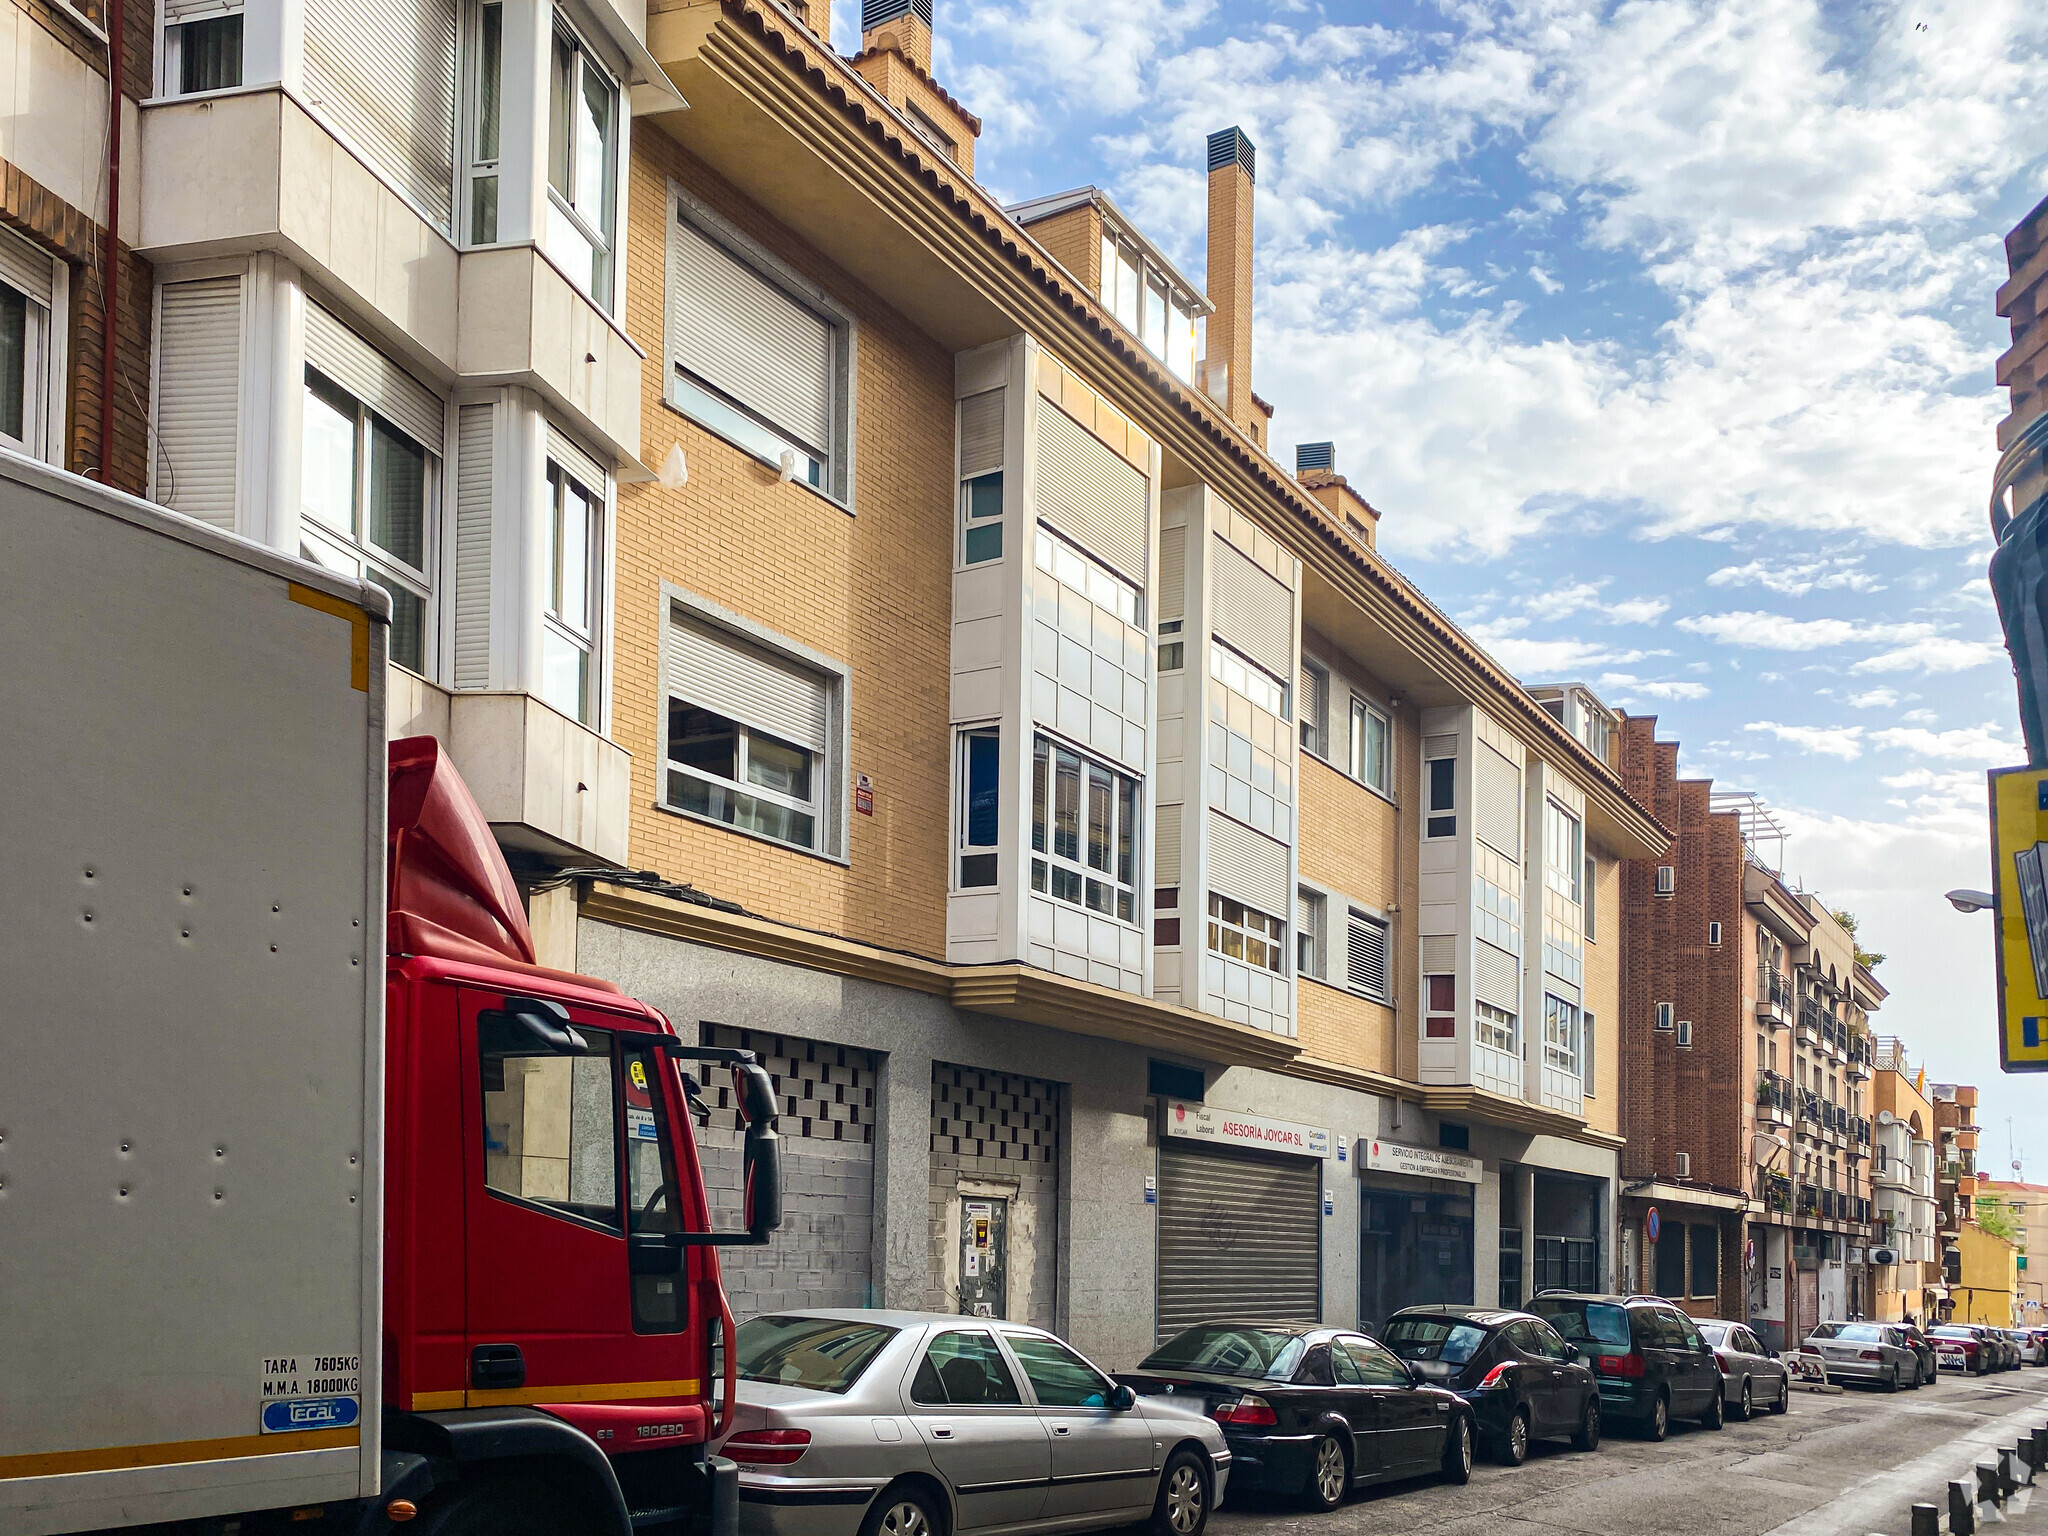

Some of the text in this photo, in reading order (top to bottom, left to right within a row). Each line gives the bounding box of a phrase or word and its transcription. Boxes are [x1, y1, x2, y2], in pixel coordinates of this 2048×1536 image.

[1196, 1111, 1211, 1122] Fiscal
[1196, 1124, 1215, 1135] Laboral
[1222, 1121, 1303, 1147] ASESORÍA JOYCAR SL
[1392, 1147, 1413, 1159] SERVICIO
[1414, 1151, 1435, 1162] INTEGRAL
[1435, 1153, 1441, 1163] DE
[264, 1357, 359, 1374] TARA 7605KG
[263, 1378, 358, 1396] M.M.A. 18000KG
